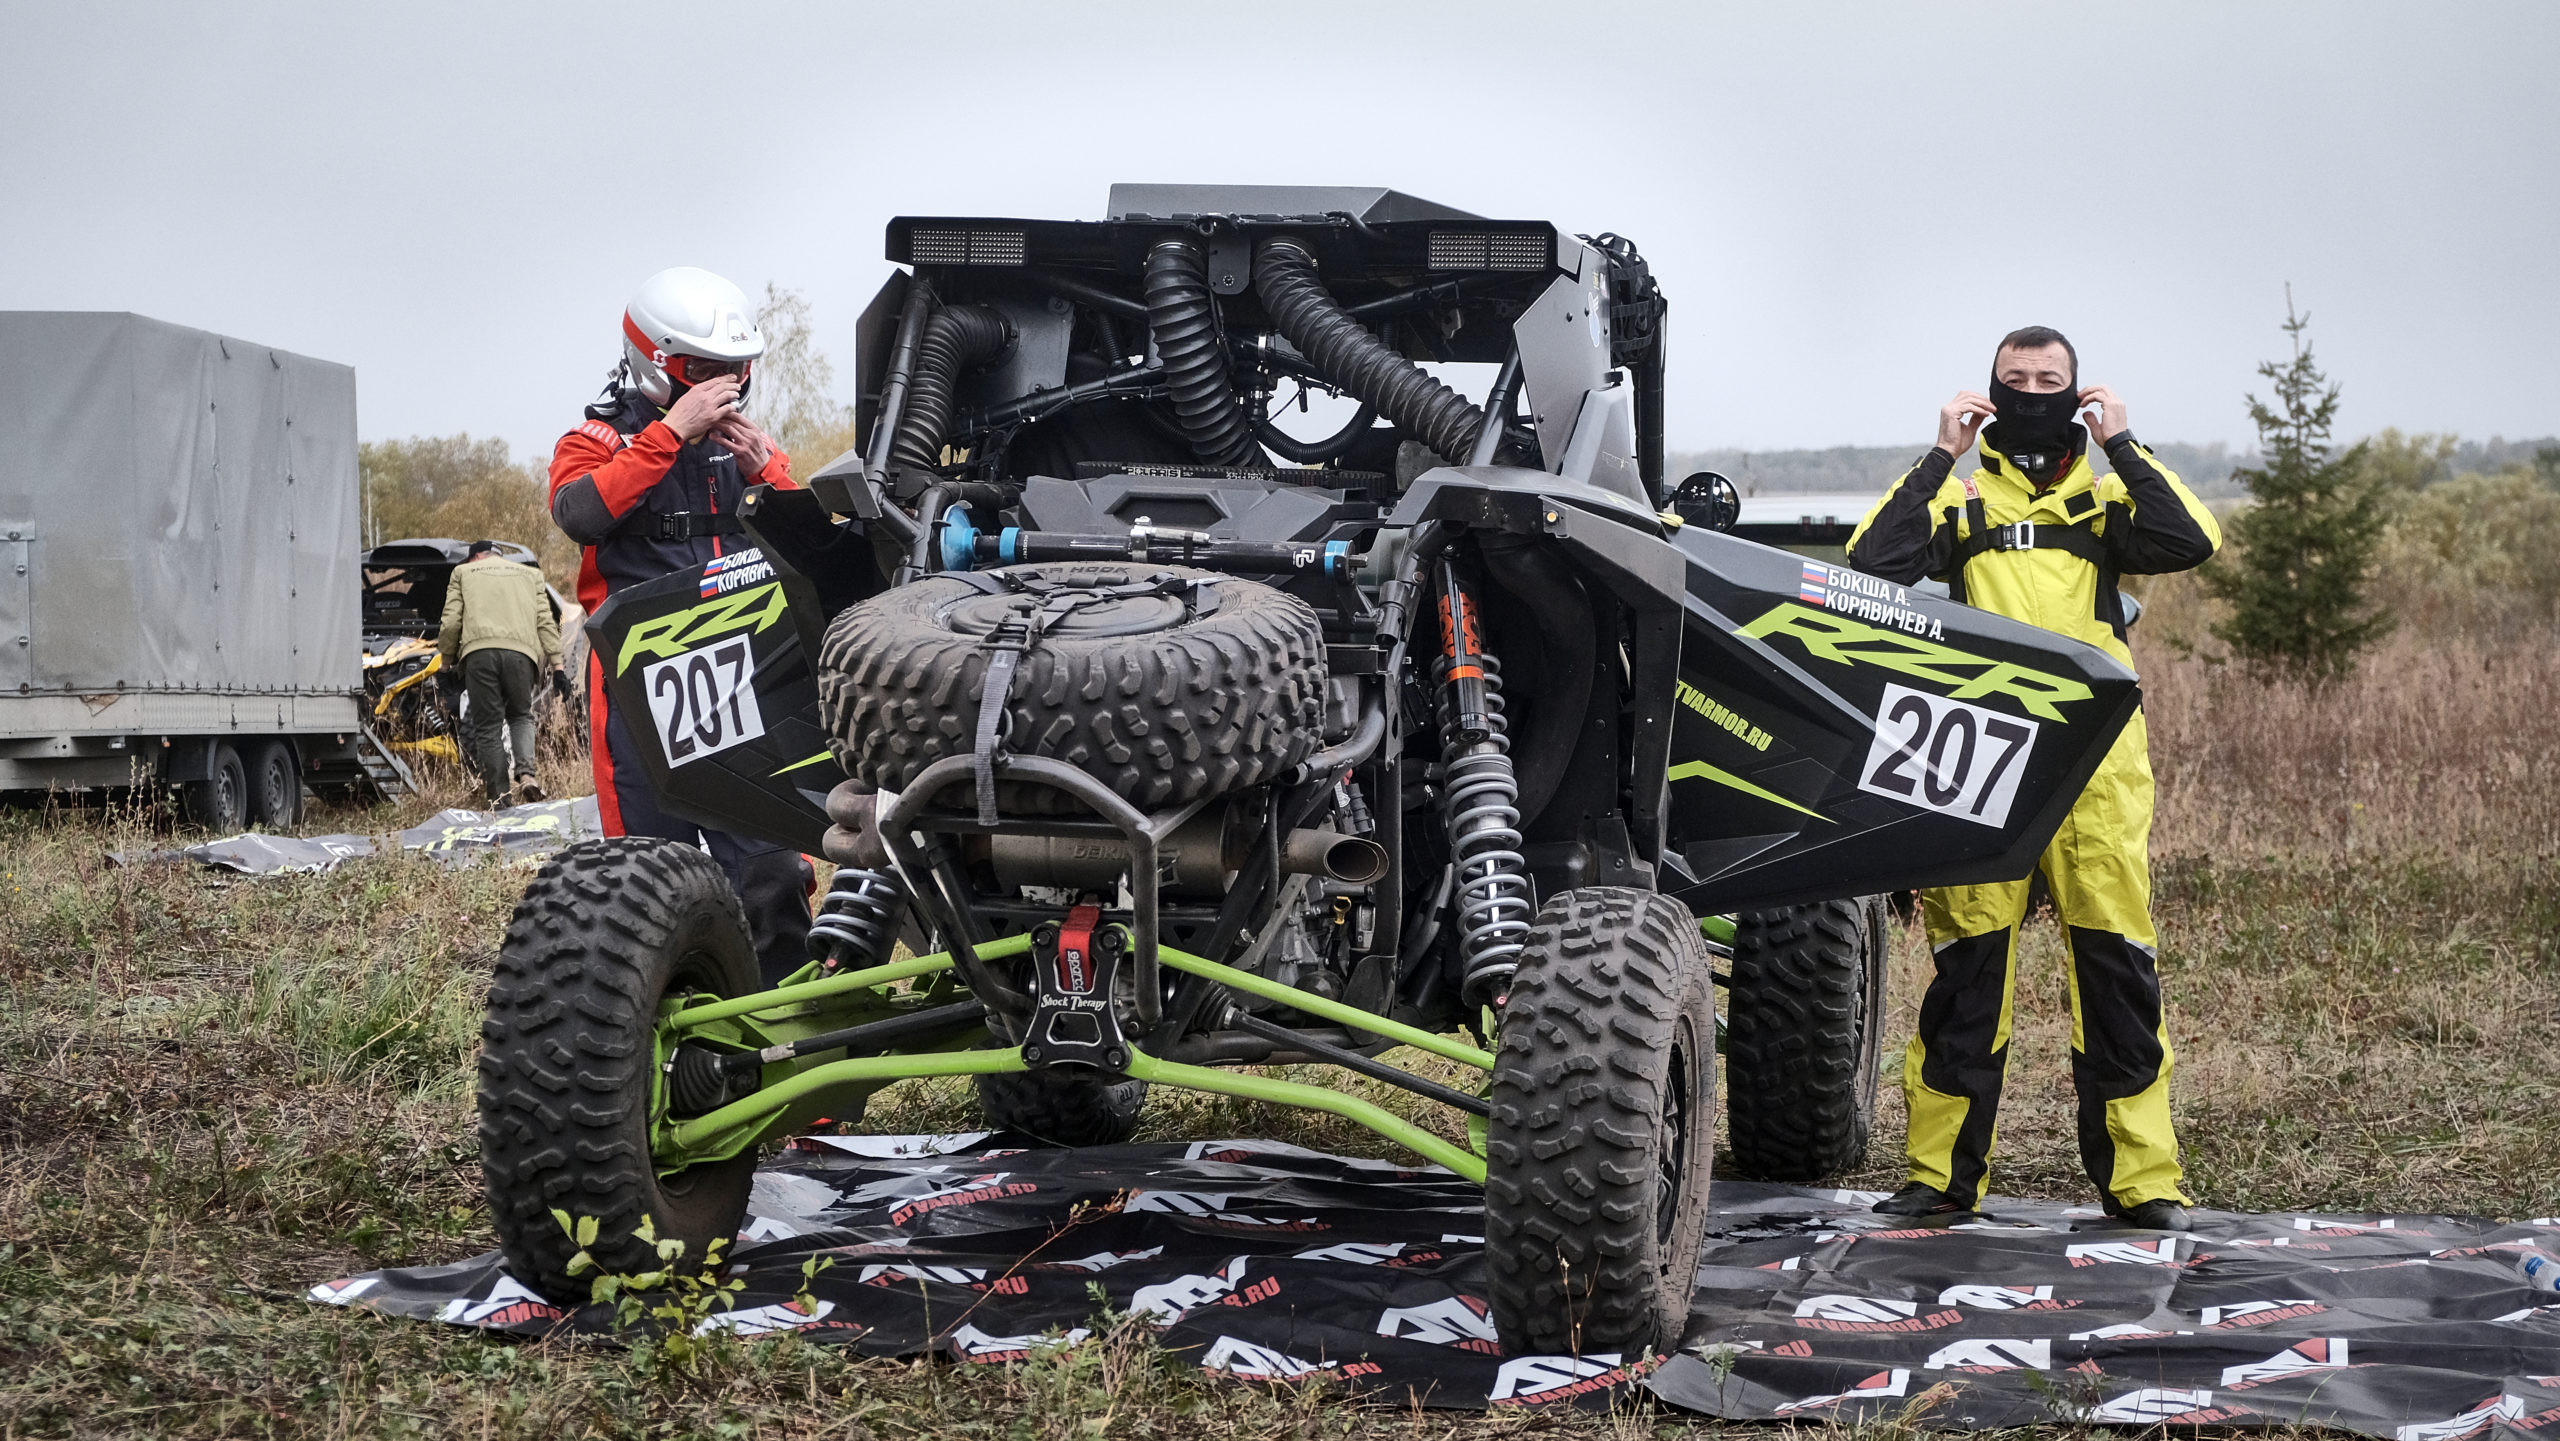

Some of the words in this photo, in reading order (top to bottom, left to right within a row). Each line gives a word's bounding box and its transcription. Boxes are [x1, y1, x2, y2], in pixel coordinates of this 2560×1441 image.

[717, 561, 776, 593] КОРЯВИЧ
[722, 548, 763, 571] БОКШ
[1827, 568, 1891, 600] БОКША
[1825, 589, 1928, 635] КОРЯВИЧЕВ
[1733, 602, 2095, 724] RZR
[655, 642, 746, 760] 207
[1675, 679, 1774, 752] TVARMOR.RU
[1869, 695, 2032, 817] 207
[1041, 994, 1069, 1009] Shock
[1070, 996, 1107, 1012] Therapy
[891, 1183, 1038, 1227] ATVARMOR.RU
